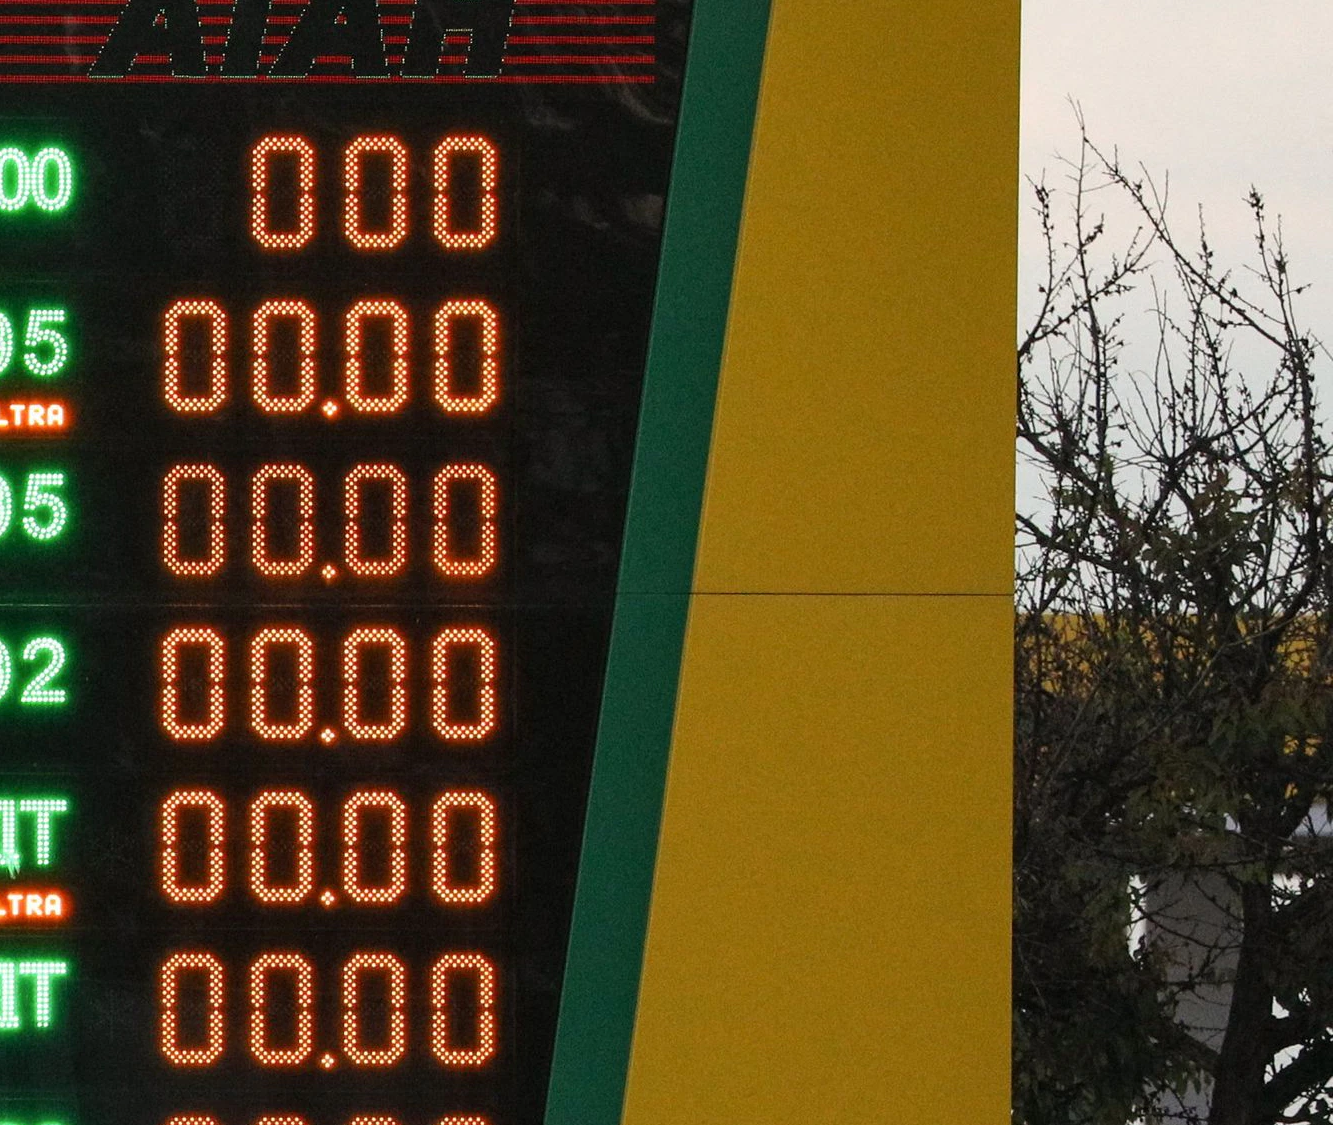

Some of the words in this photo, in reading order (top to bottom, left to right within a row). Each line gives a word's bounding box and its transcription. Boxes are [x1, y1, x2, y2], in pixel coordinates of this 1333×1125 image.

[251, 136, 498, 250] 000
[164, 299, 498, 416] 00.00
[163, 463, 497, 580] 00.00
[162, 627, 496, 743] 00.00
[161, 790, 496, 906] 00.00
[161, 953, 496, 1068] 00.00
